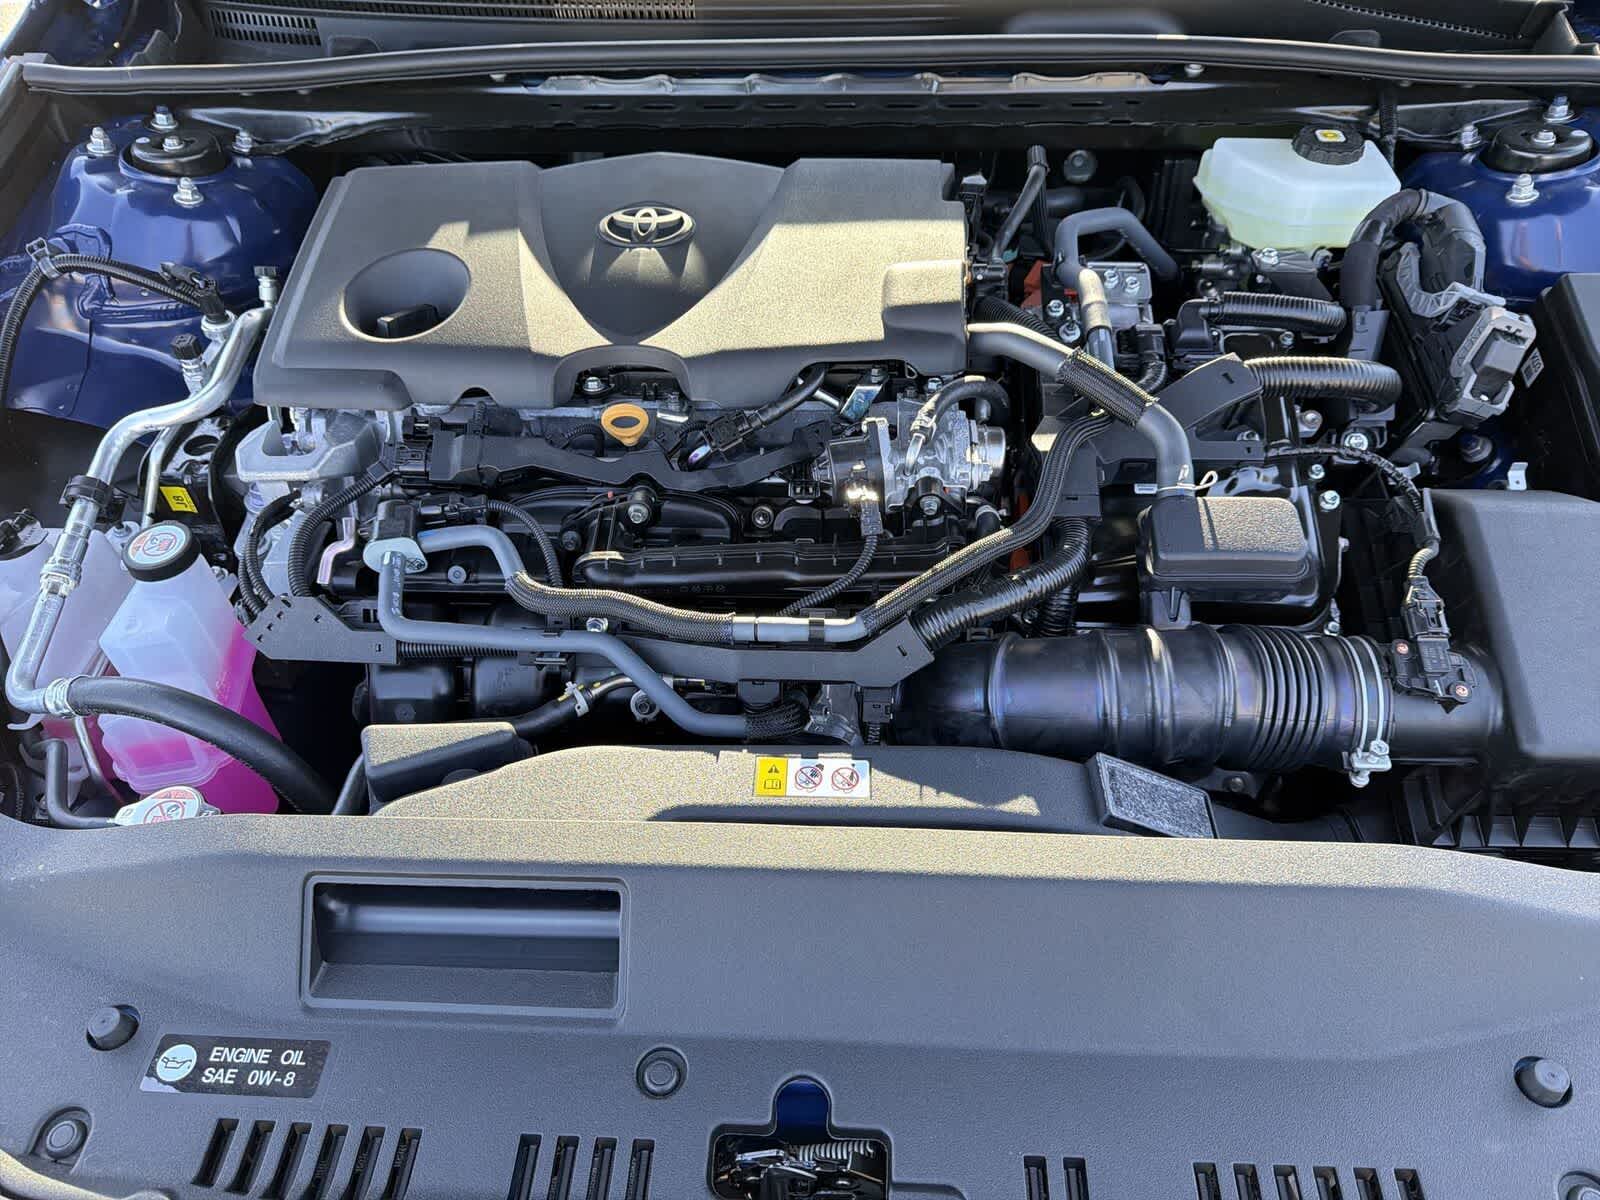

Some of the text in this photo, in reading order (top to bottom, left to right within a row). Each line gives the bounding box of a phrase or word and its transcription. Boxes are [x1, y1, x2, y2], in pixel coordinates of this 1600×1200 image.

[209, 1046, 306, 1066] ENGINE OIL
[201, 1067, 296, 1087] SAE 0W-8
